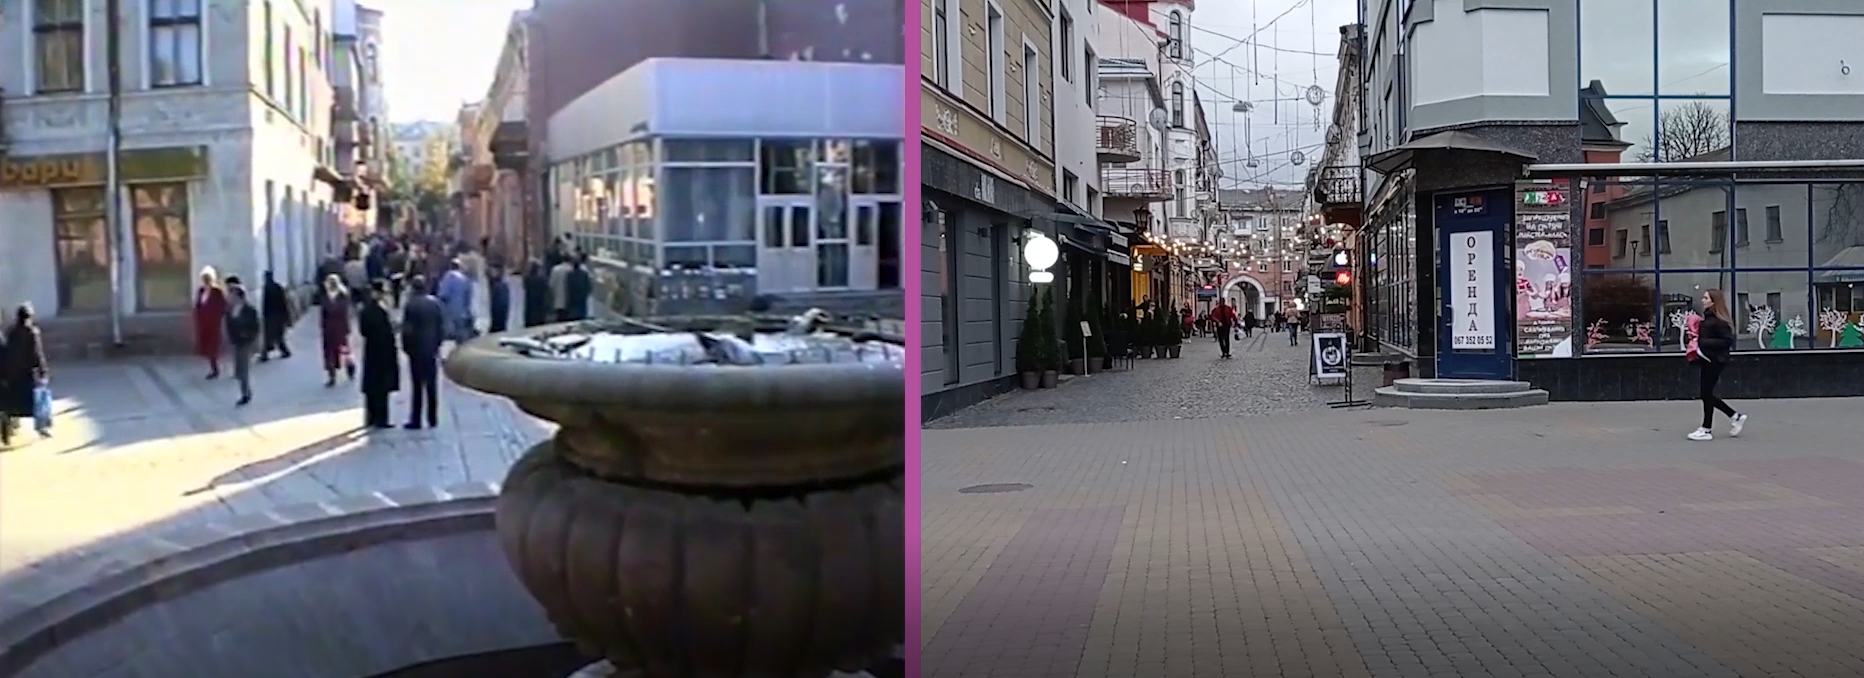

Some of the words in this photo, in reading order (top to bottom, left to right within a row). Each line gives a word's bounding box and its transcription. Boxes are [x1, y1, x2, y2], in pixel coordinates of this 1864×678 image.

[1467, 236, 1478, 331] ОРЕНДА
[1454, 336, 1464, 345] 067
[1465, 336, 1476, 345] 352
[1477, 336, 1485, 345] 05
[1485, 335, 1493, 345] 52
